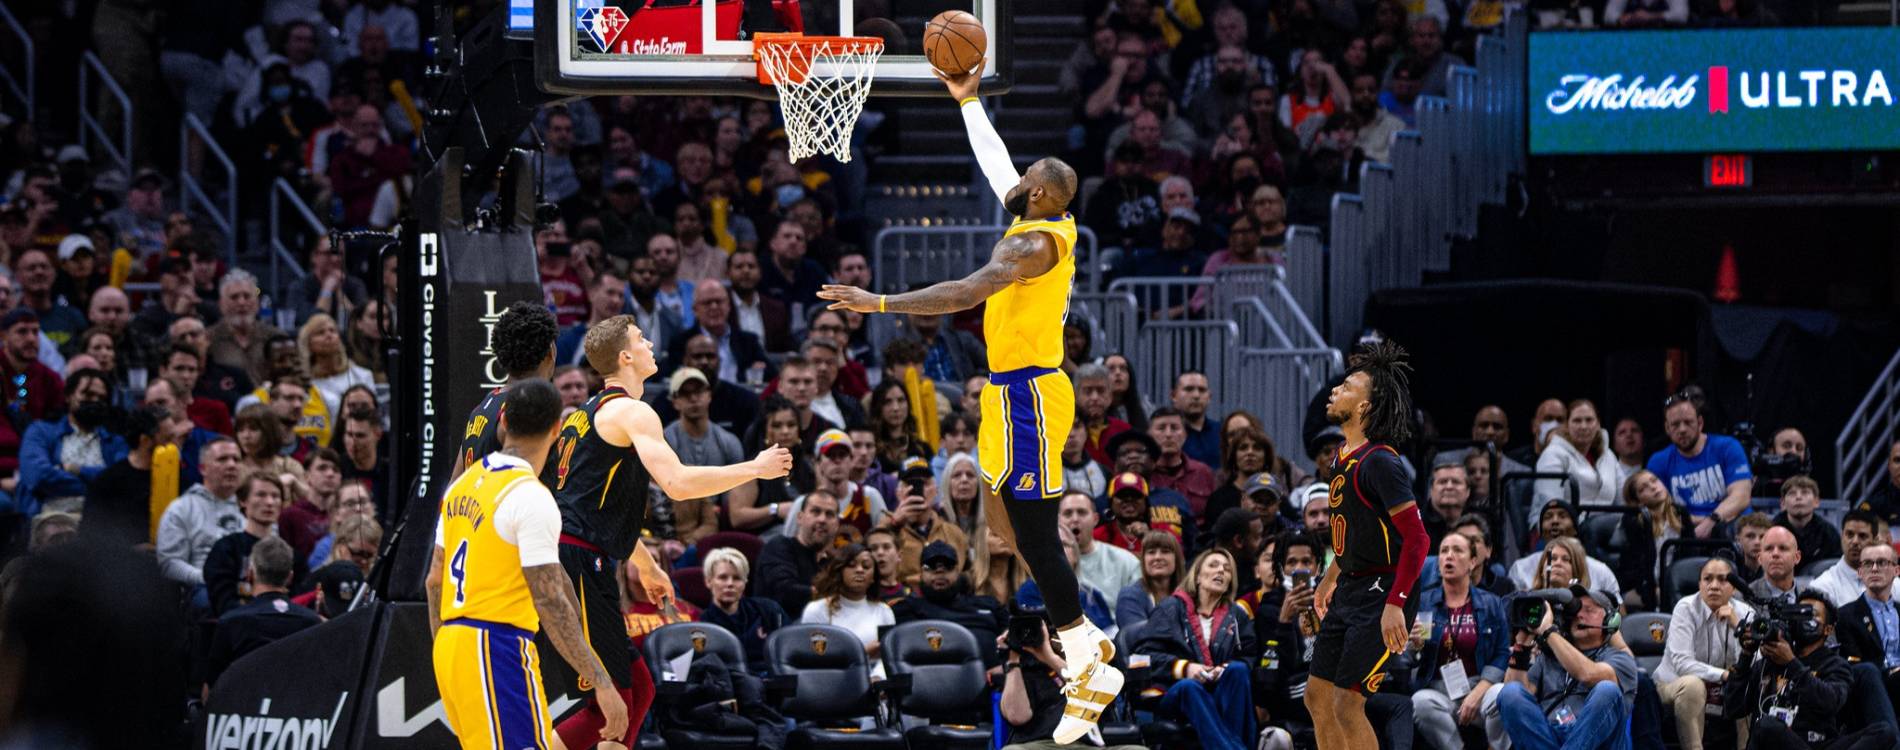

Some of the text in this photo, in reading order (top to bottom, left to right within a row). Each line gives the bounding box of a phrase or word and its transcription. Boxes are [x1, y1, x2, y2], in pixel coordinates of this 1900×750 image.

[1546, 70, 1892, 114] Michelob ULTRA
[1711, 154, 1745, 185] EXIT
[418, 283, 434, 498] Cleveland Clinic
[447, 495, 485, 533] AUGUSTIN
[450, 539, 468, 605] 4
[206, 698, 322, 750] verizon
